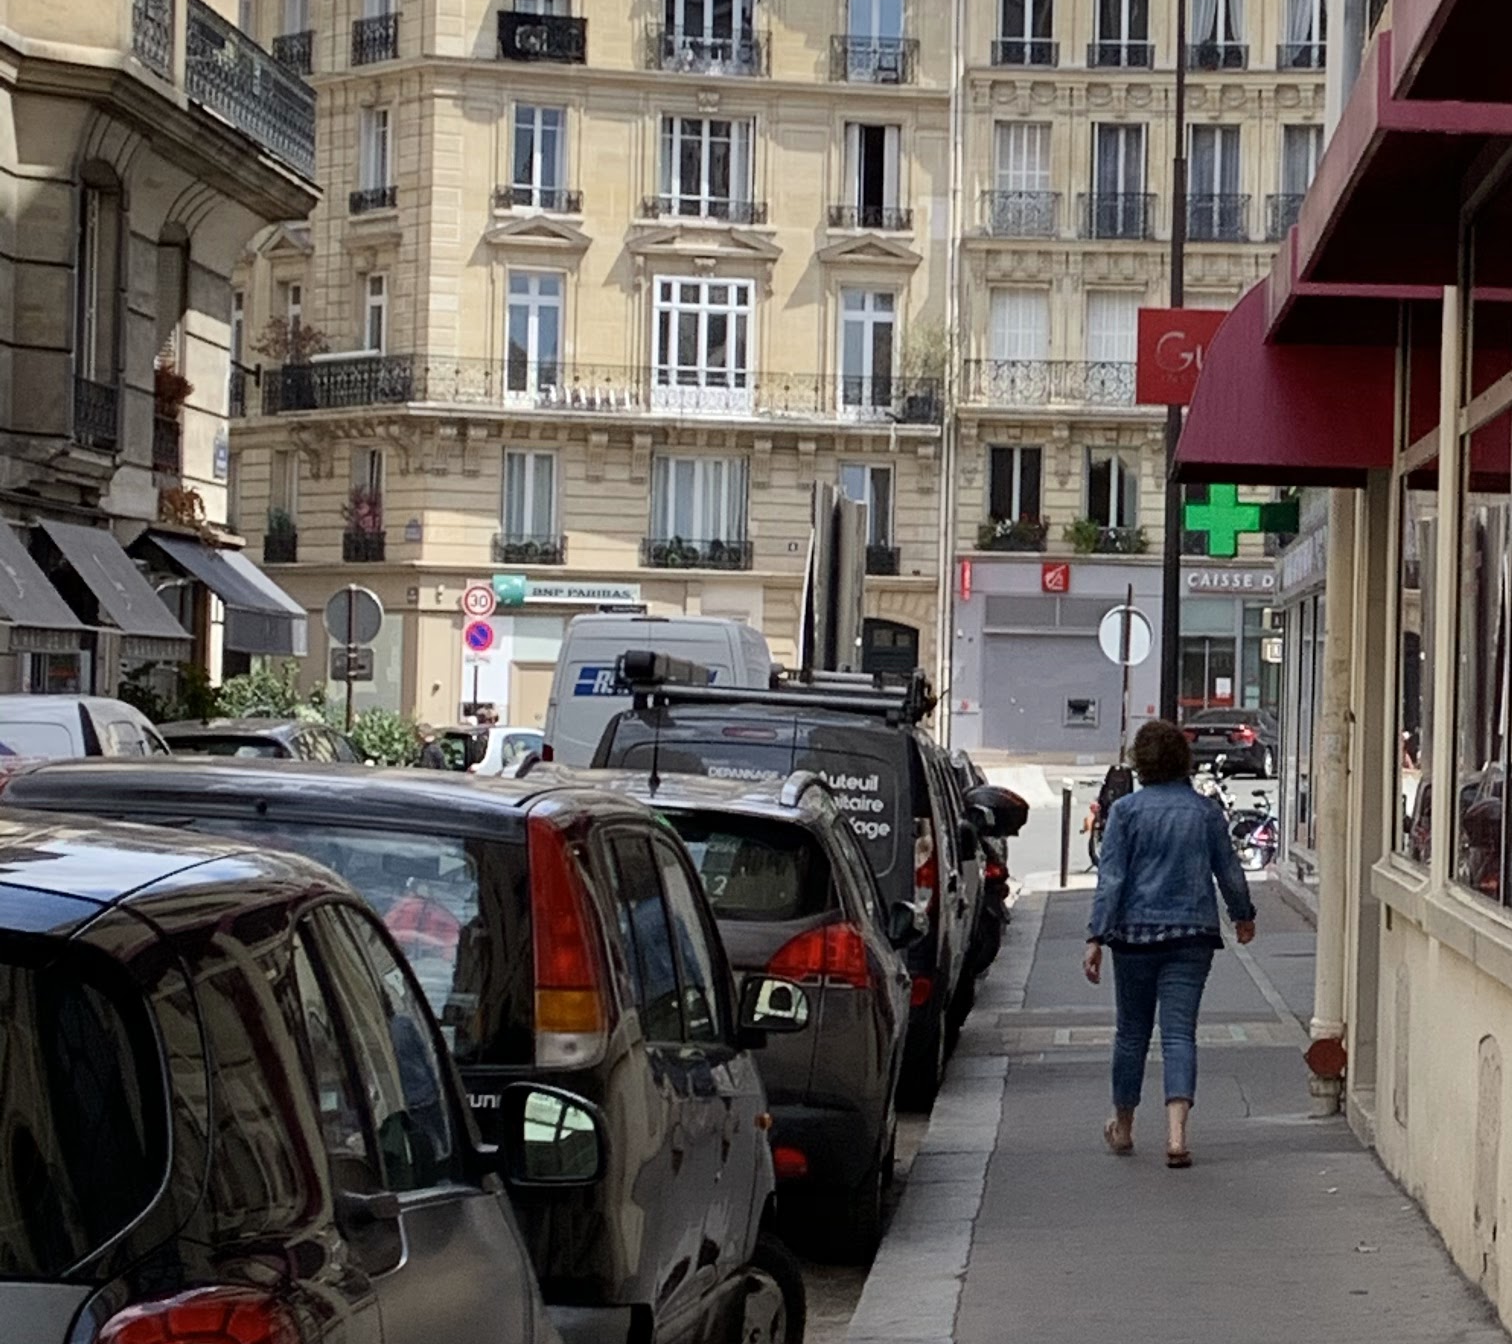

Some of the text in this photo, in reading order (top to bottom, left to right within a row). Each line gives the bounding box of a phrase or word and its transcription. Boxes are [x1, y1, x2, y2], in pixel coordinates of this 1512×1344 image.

[1187, 572, 1253, 588] CAISSE
[532, 587, 565, 597] BNP
[469, 593, 489, 608] 30
